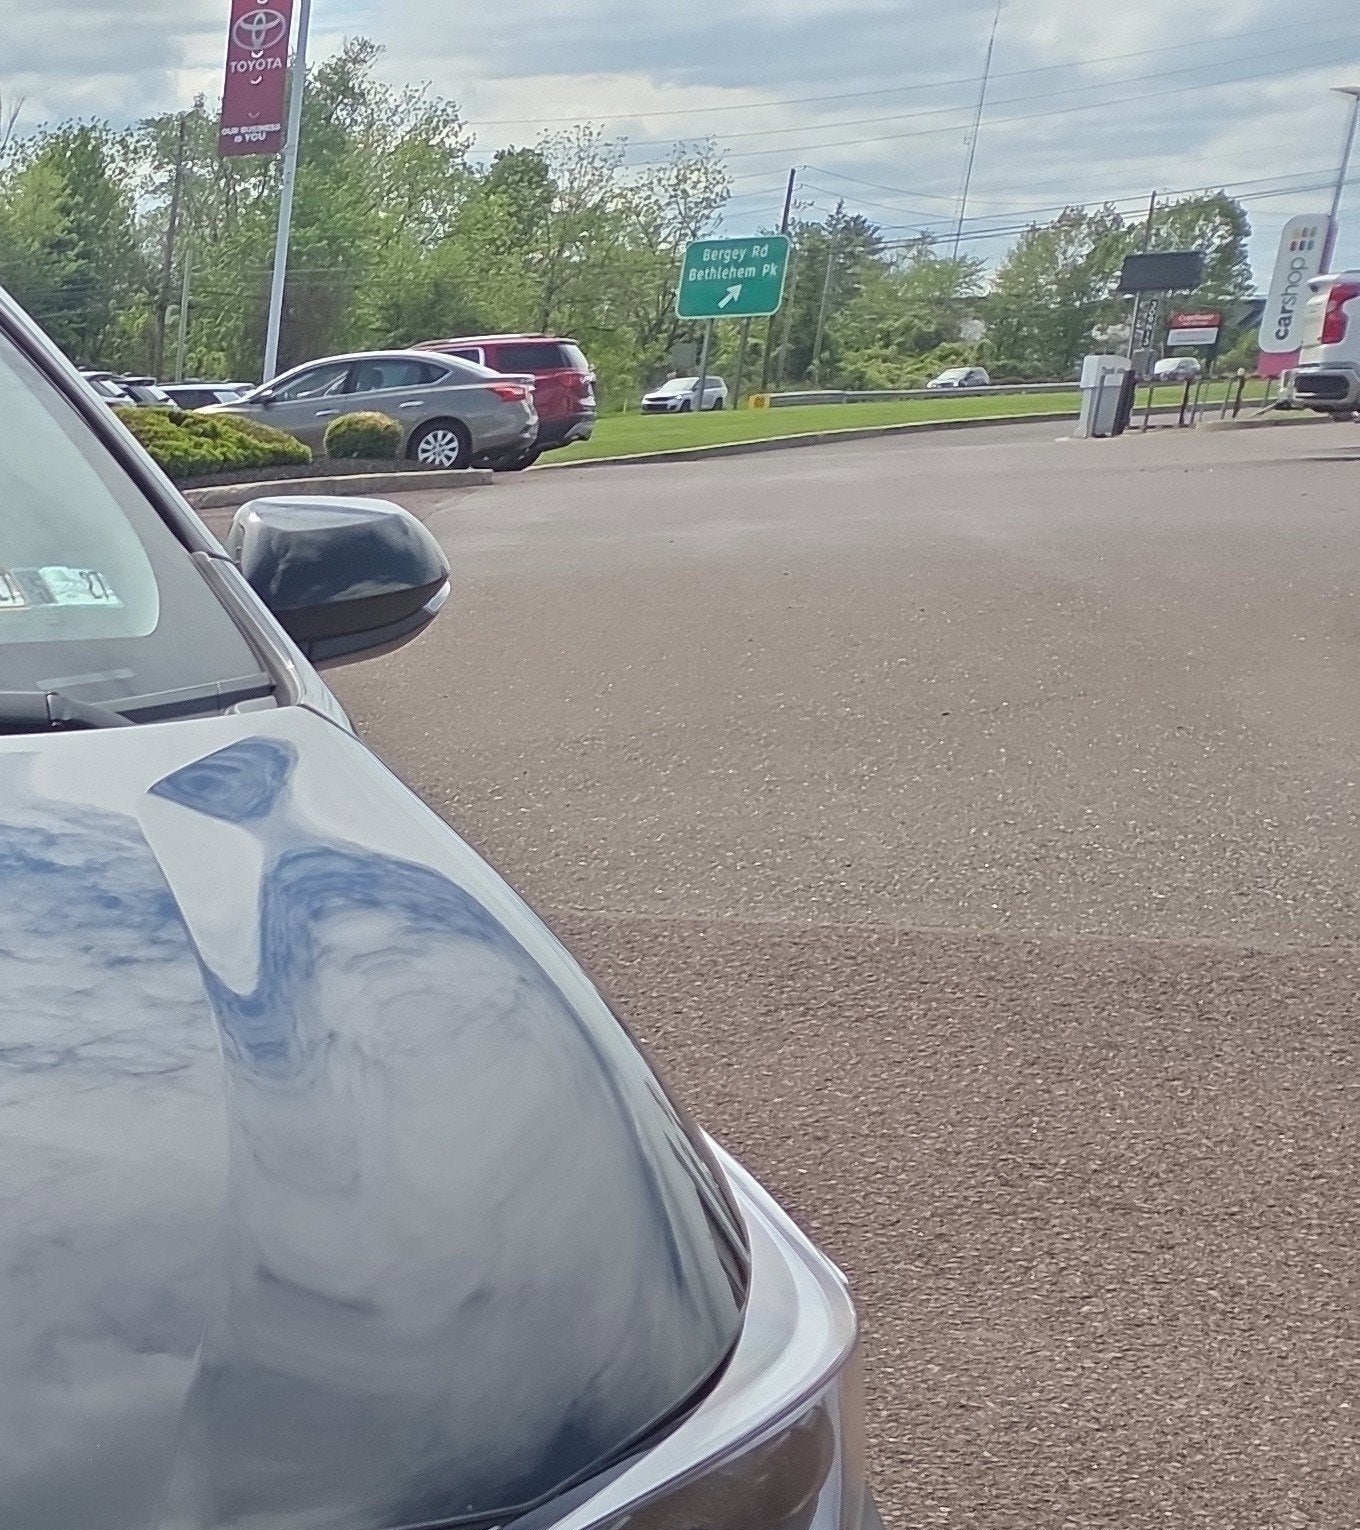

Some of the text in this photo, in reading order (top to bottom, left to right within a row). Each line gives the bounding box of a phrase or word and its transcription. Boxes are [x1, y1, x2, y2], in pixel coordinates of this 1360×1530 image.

[230, 57, 283, 73] TOYOTA
[244, 131, 267, 142] YOU
[703, 244, 769, 263] Bergey Rd
[689, 263, 778, 281] Bethlehem Pk
[1275, 256, 1307, 340] carshop
